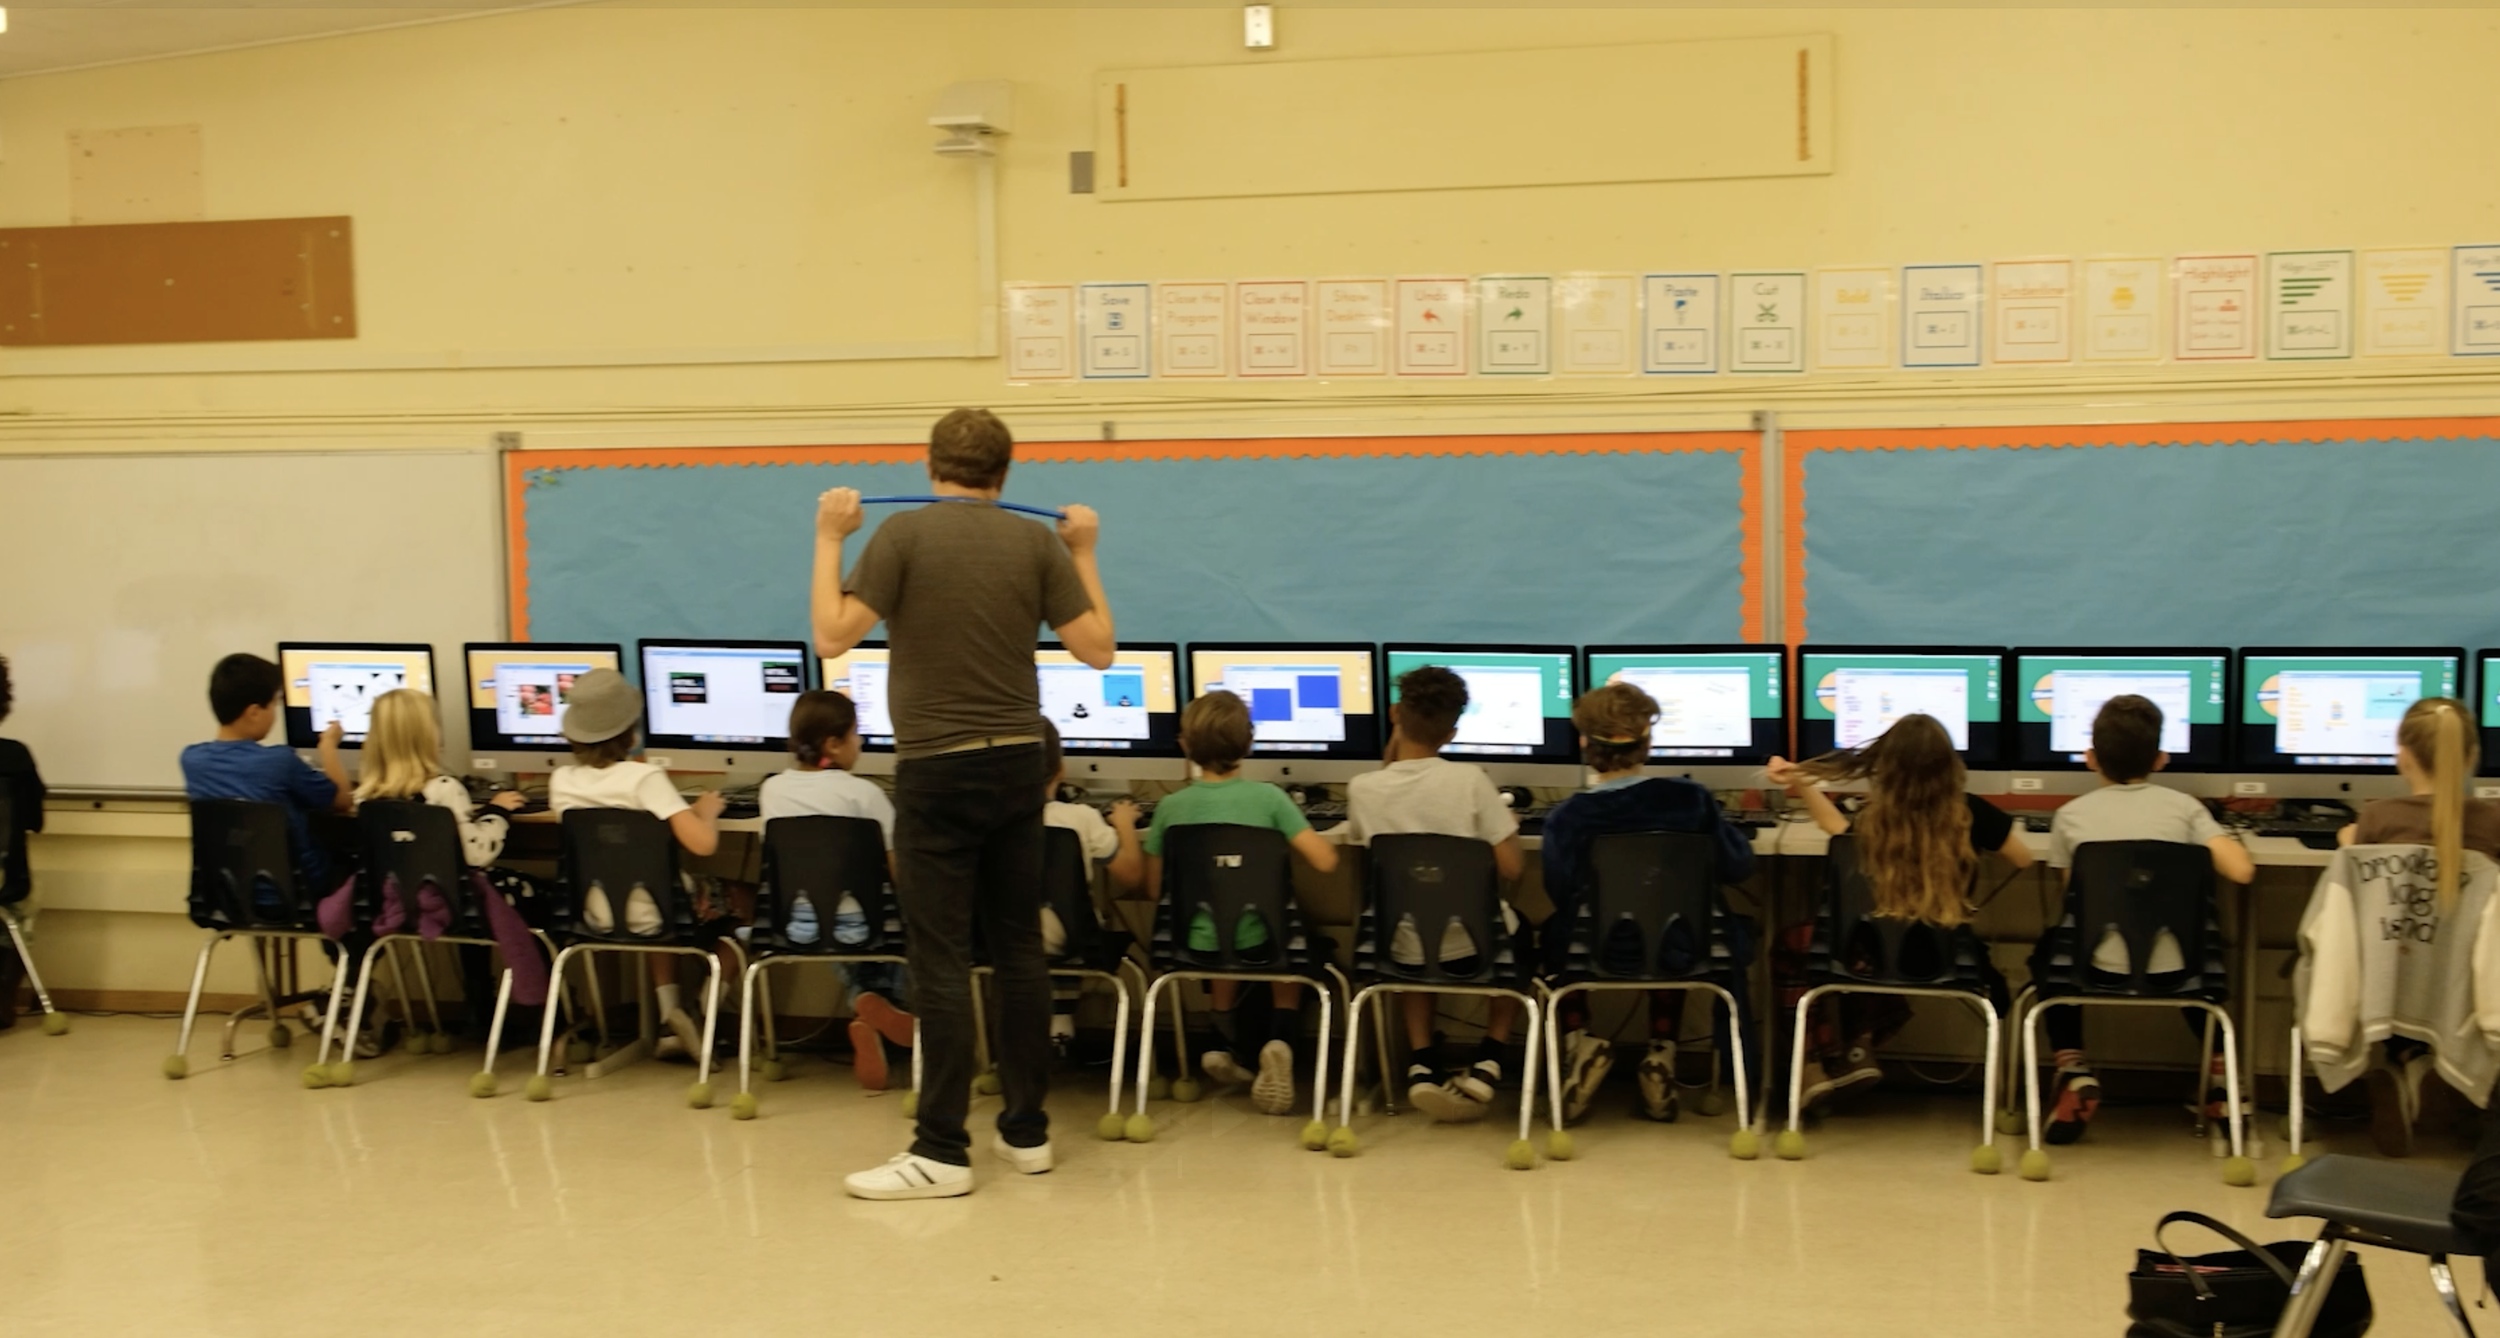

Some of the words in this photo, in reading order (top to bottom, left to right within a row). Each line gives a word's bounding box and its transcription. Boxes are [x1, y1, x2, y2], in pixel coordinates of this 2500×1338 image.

[2184, 265, 2250, 284] Highlight
[1414, 288, 1448, 302] Undo
[1498, 286, 1532, 300] Redo
[1664, 284, 1699, 298] Paste
[1752, 282, 1780, 296] Cut
[1022, 294, 1058, 311] Open
[1099, 293, 1131, 306] Save
[1166, 291, 1198, 305] Close
[1201, 291, 1222, 304] the
[1243, 291, 1276, 305] Close
[1279, 290, 1301, 304] the
[1026, 314, 1054, 327] Files
[1167, 310, 1219, 327] Program
[1245, 311, 1298, 324] Window
